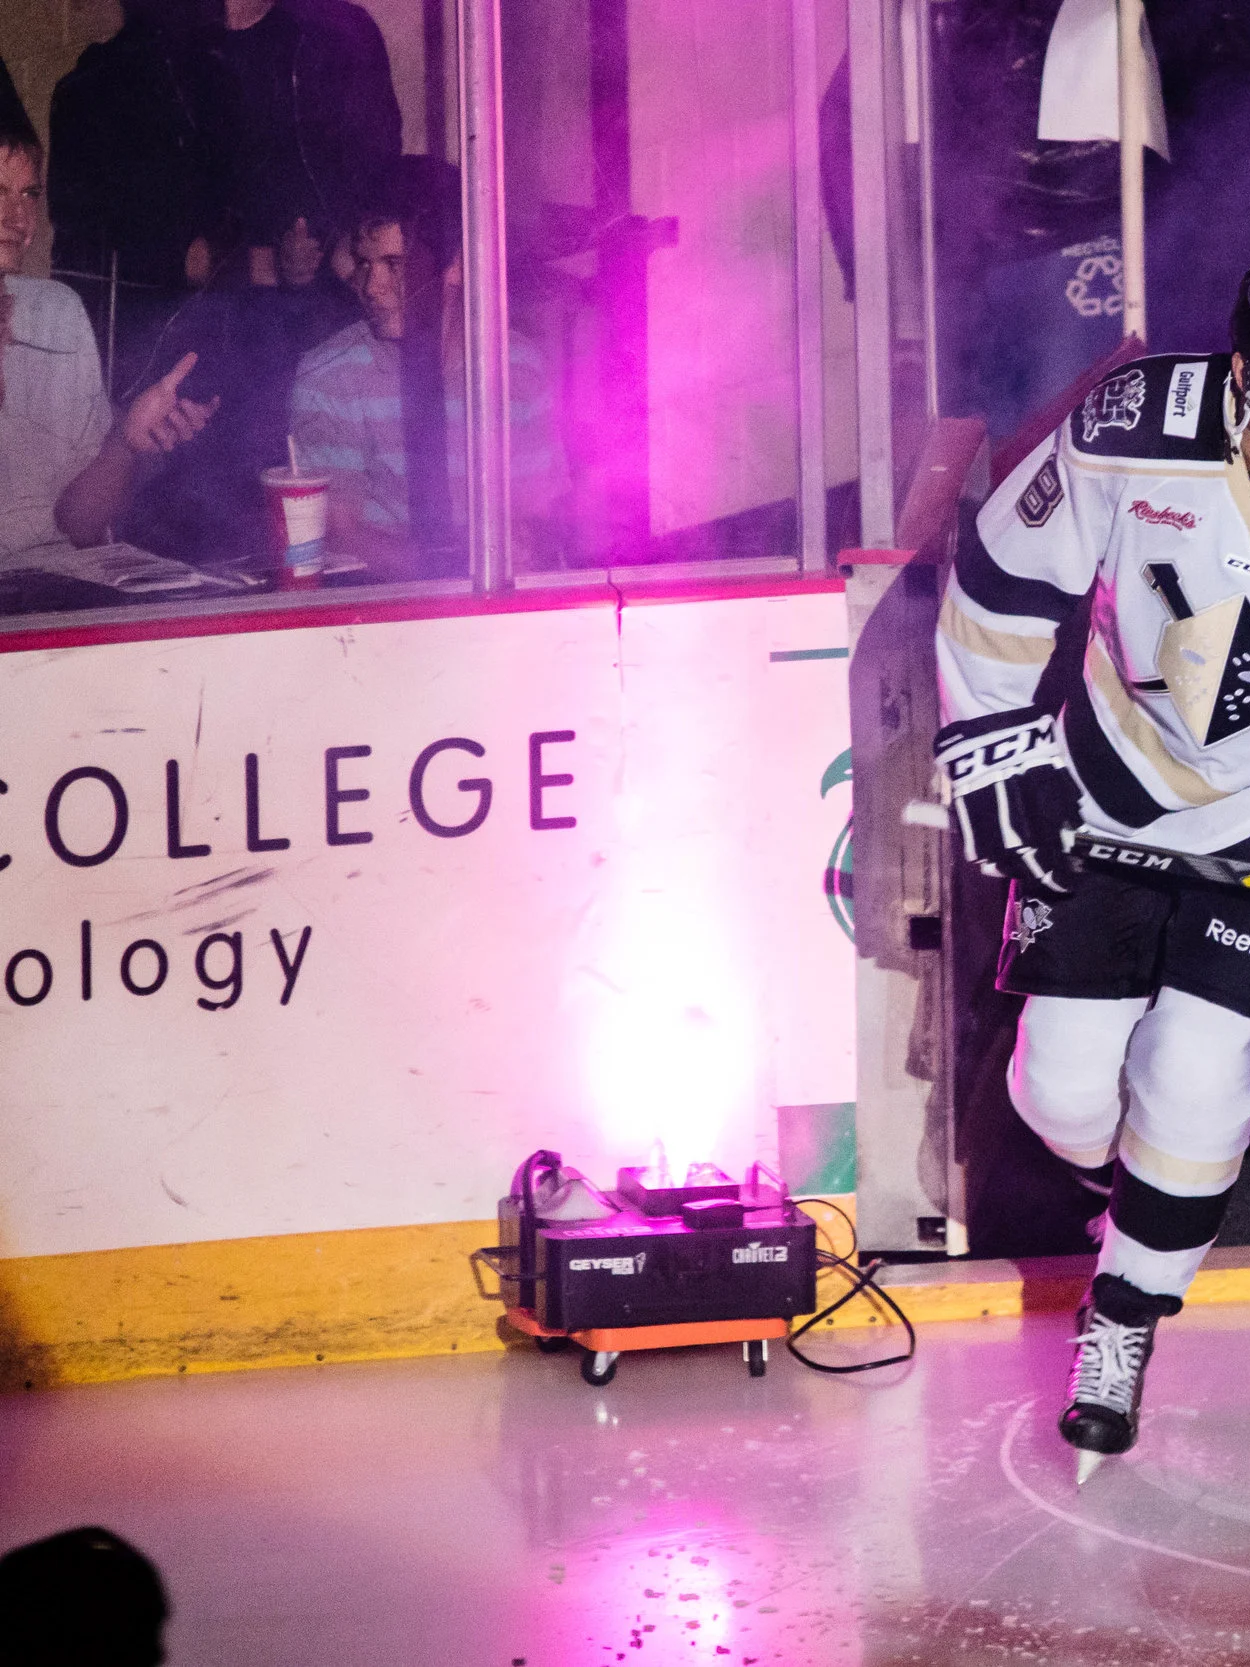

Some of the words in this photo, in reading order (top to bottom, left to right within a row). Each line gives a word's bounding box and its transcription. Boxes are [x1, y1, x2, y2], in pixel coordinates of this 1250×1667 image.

[1172, 371, 1194, 418] Gulfport
[946, 724, 1056, 781] CCM
[0, 730, 577, 872] OLLEGE
[1088, 844, 1173, 871] CCM
[5, 919, 312, 1012] ology
[569, 1257, 635, 1271] GEYSER
